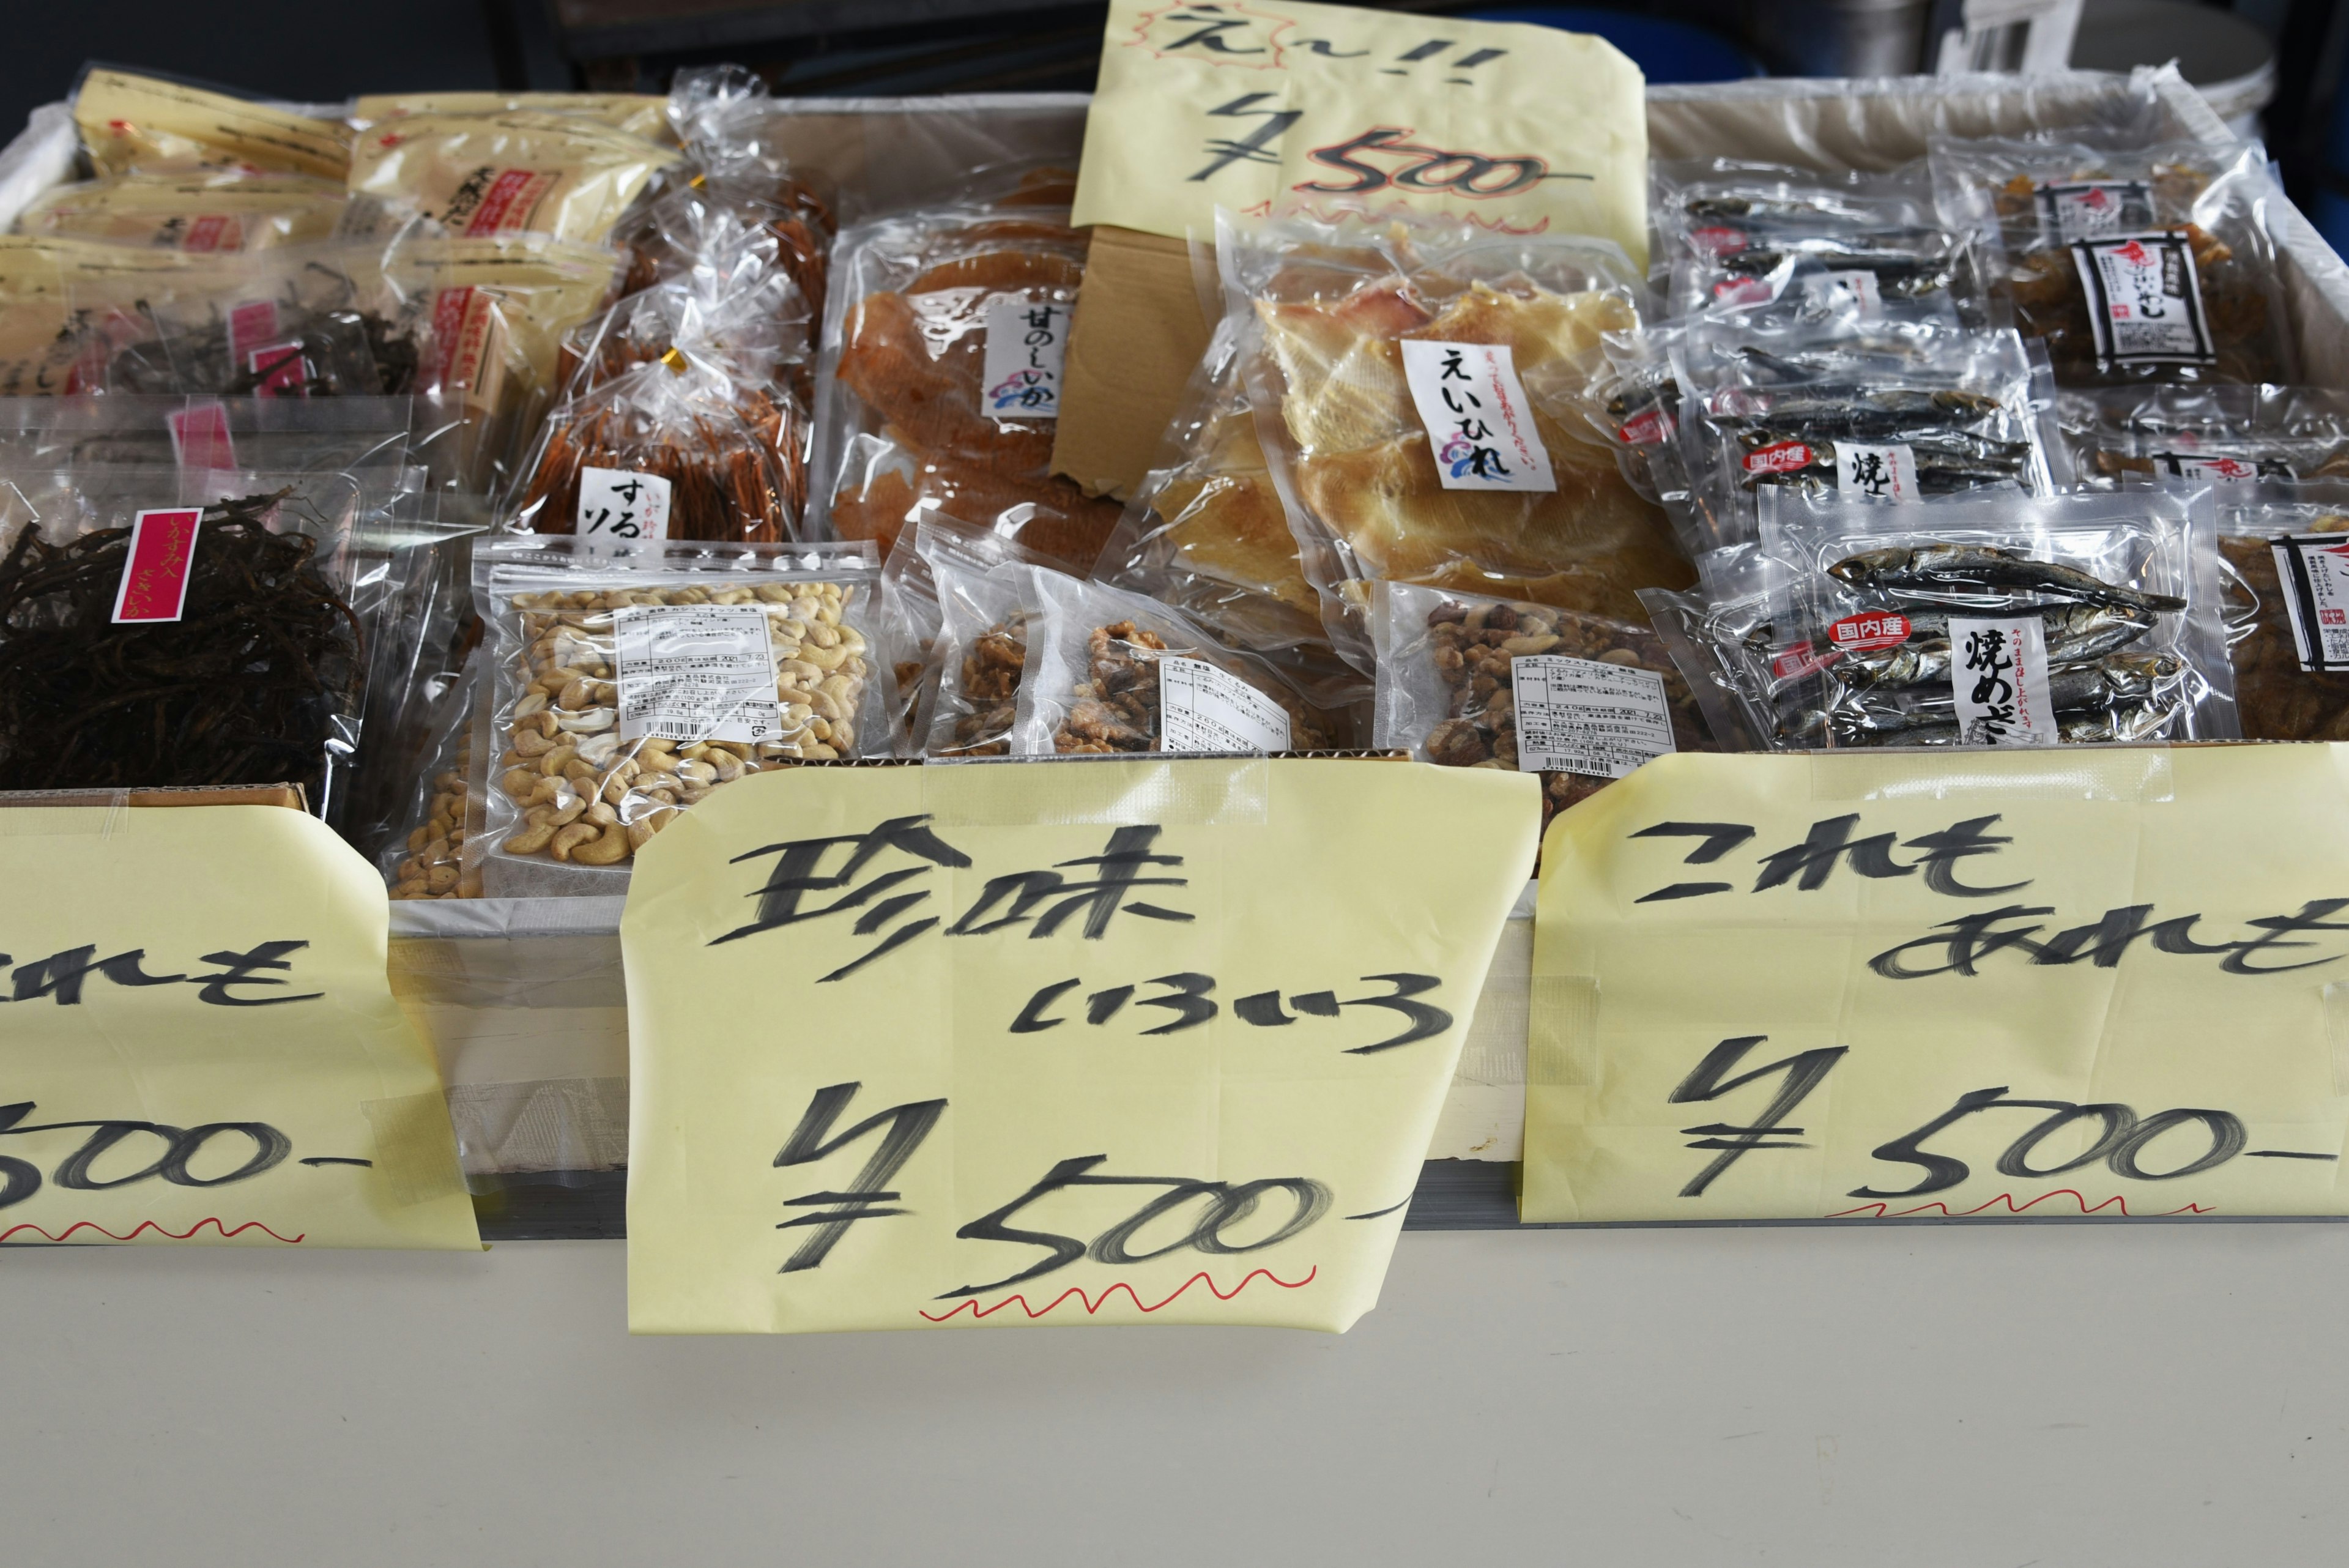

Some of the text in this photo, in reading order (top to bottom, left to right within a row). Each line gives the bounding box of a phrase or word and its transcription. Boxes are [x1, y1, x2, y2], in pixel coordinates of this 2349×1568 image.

[1020, 307, 1061, 406] 甘のしいか
[1441, 349, 1510, 477] えいひれ
[1750, 444, 1805, 469] 国内産
[1837, 615, 1903, 641] 国内産
[1965, 630, 2016, 745] 焼めざ
[705, 814, 1195, 983] 珍味
[1627, 813, 2035, 904] これも
[0, 940, 325, 1006] れも
[1868, 897, 2349, 979] あれも
[1008, 972, 1453, 1055] いろいろ
